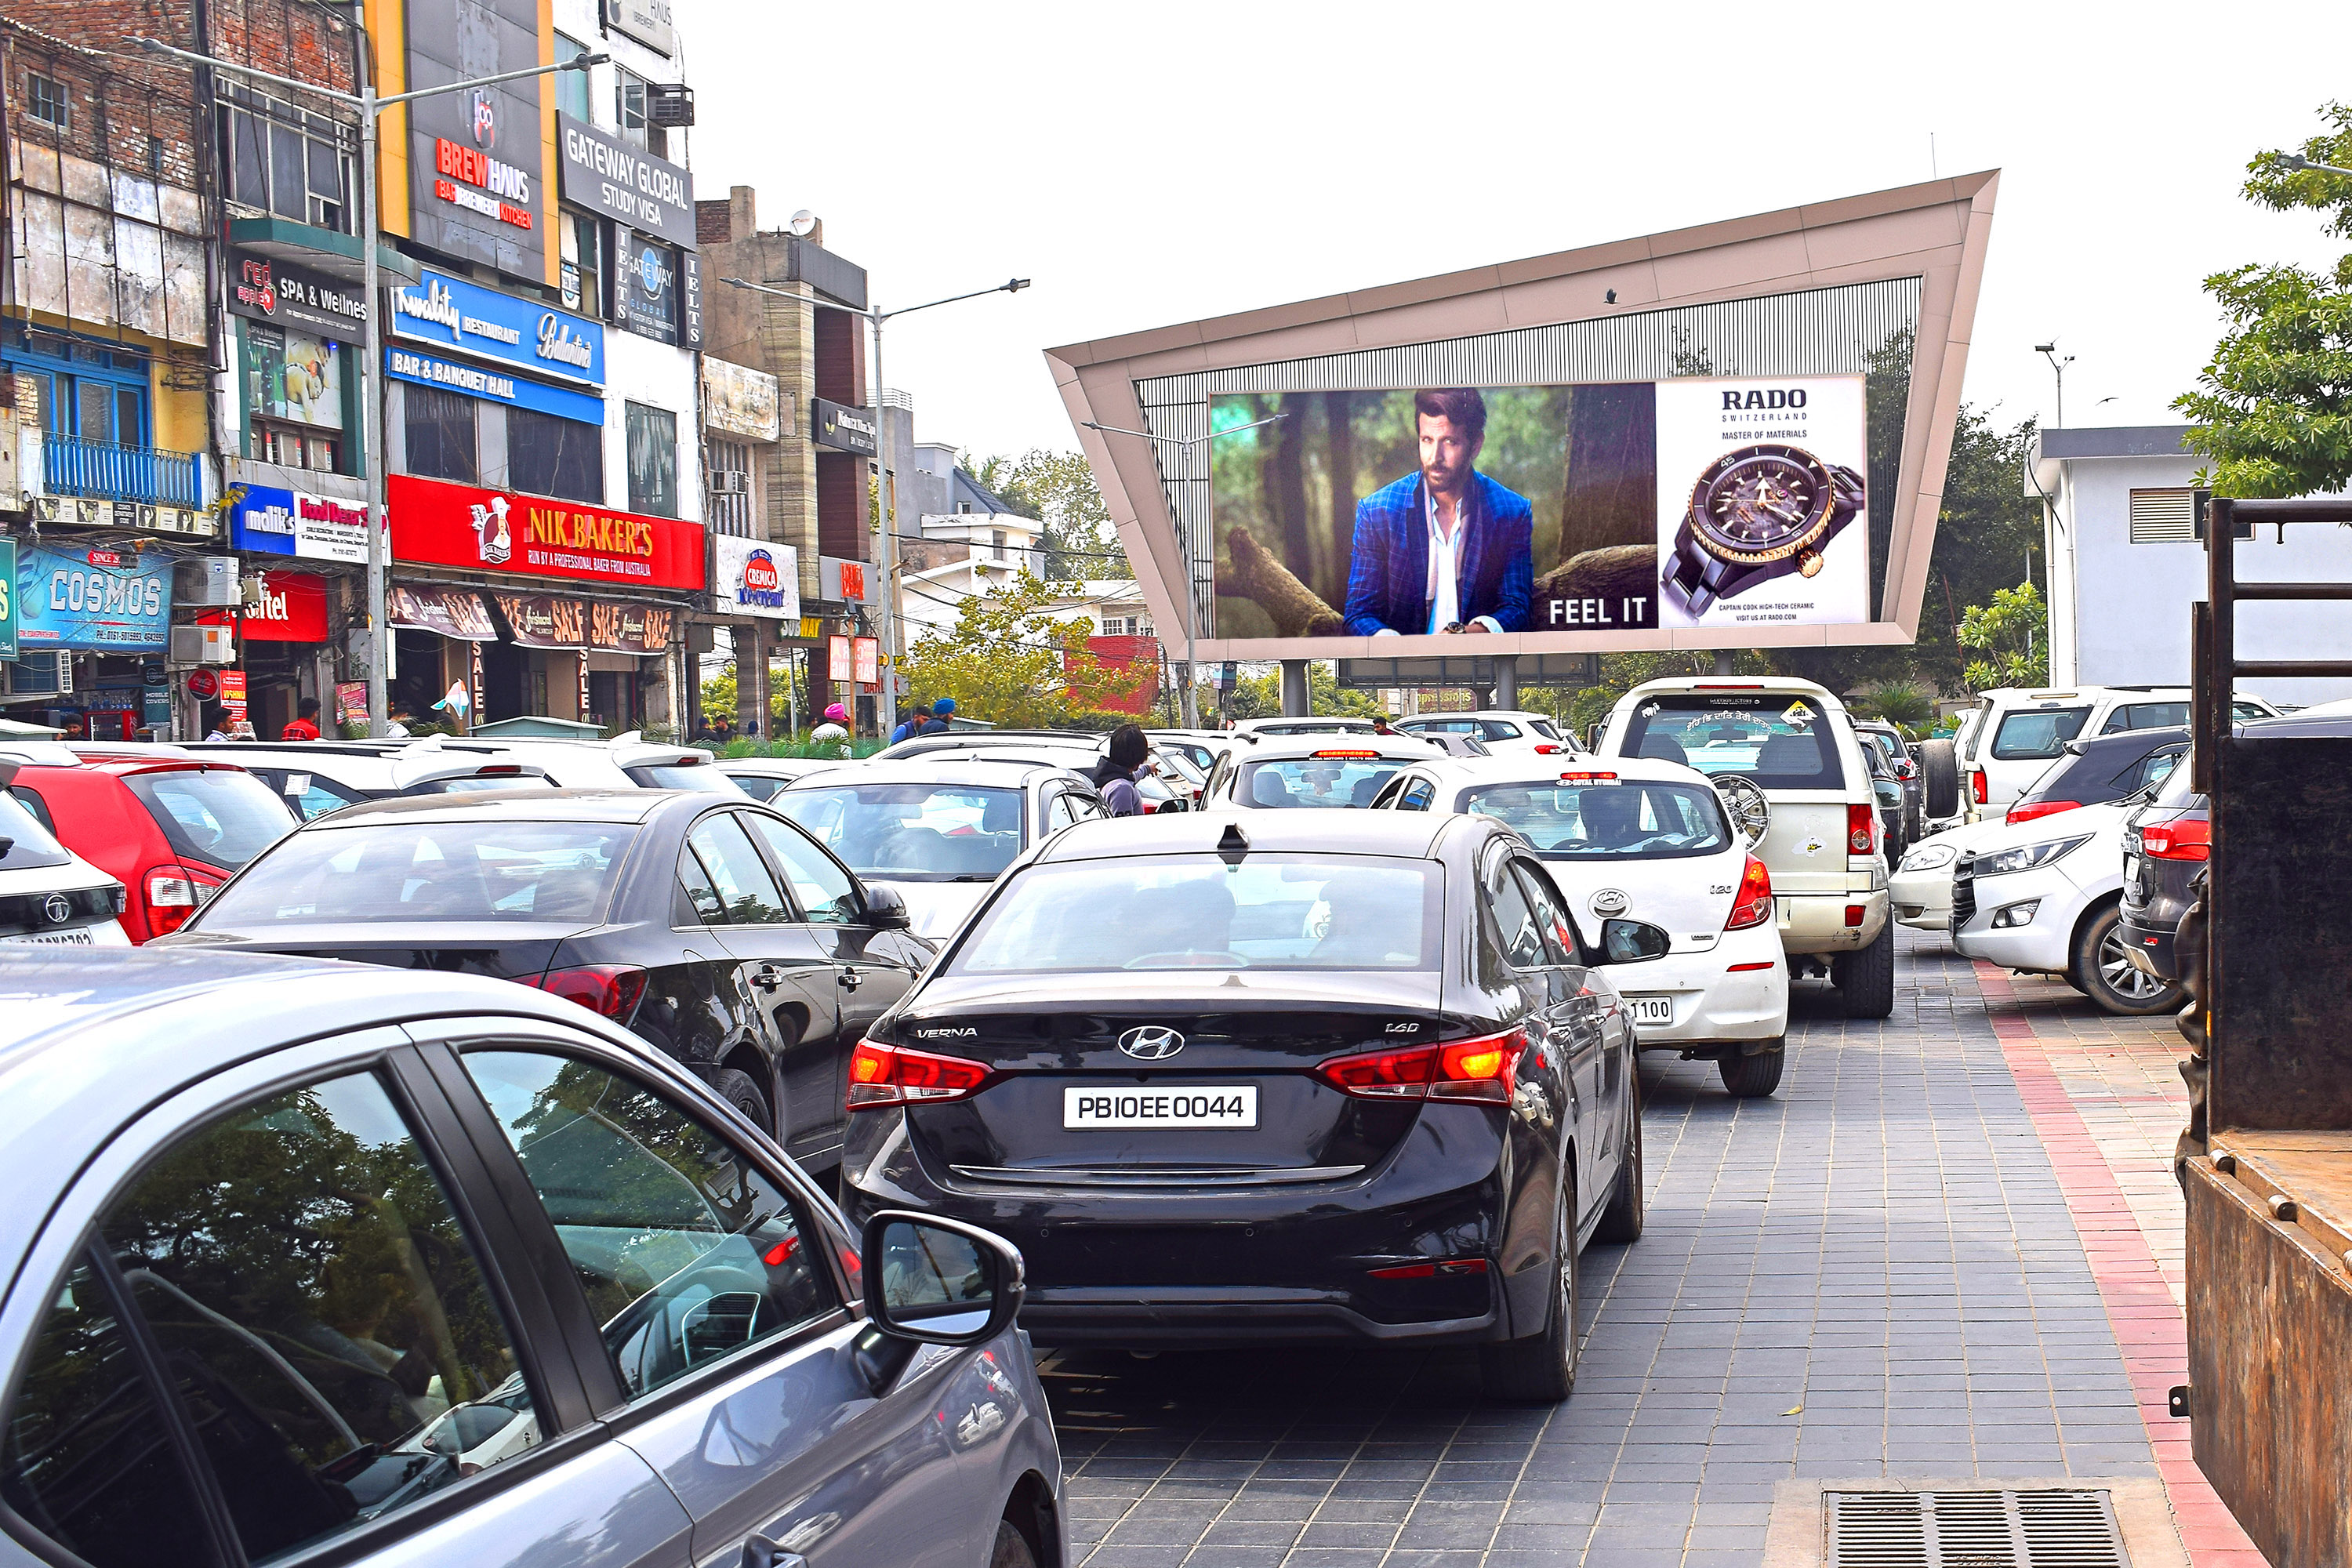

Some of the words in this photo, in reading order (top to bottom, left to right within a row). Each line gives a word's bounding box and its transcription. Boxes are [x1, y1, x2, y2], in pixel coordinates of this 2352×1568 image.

[567, 128, 635, 187] GATEWAY
[637, 162, 688, 211] GLOBAL
[601, 182, 637, 216] STUDY
[638, 197, 662, 227] VISA
[617, 230, 628, 320] IELTS
[280, 277, 305, 303] SPA
[309, 285, 318, 307] &
[320, 289, 367, 321] Wellnes
[688, 259, 700, 343] IELTS
[461, 316, 521, 345] RESTAURANT
[392, 352, 420, 377] BAR
[420, 360, 432, 379] &
[432, 362, 487, 392] BANQUET
[486, 376, 516, 398] HALL
[1722, 389, 1807, 410] RADO
[1722, 412, 1807, 423] SWITZERLAND
[1722, 431, 1752, 440] MASTER
[1755, 430, 1764, 439] OF
[1766, 430, 1807, 438] MATERIALS
[1720, 456, 1736, 468] 45
[529, 507, 568, 546] NIK
[574, 514, 653, 557] BAKER'S
[93, 553, 111, 562] SINCE
[528, 550, 540, 564] RUN
[541, 552, 548, 565] BY
[549, 553, 554, 566] A
[554, 554, 593, 571] PROFESSIONAL
[593, 558, 610, 572] BAKER
[610, 560, 625, 574] FROM
[625, 562, 652, 576] AUSTRALIA
[747, 568, 777, 586] CREMICA
[49, 569, 162, 616] COSMOS
[1549, 598, 1612, 624] FEEL
[1623, 597, 1647, 622] IT
[552, 600, 583, 642] SALE
[591, 603, 619, 647] SALE
[644, 610, 672, 649] SALE
[472, 641, 484, 709] SALE
[579, 649, 590, 709] SALE
[916, 1026, 978, 1039] VERNA
